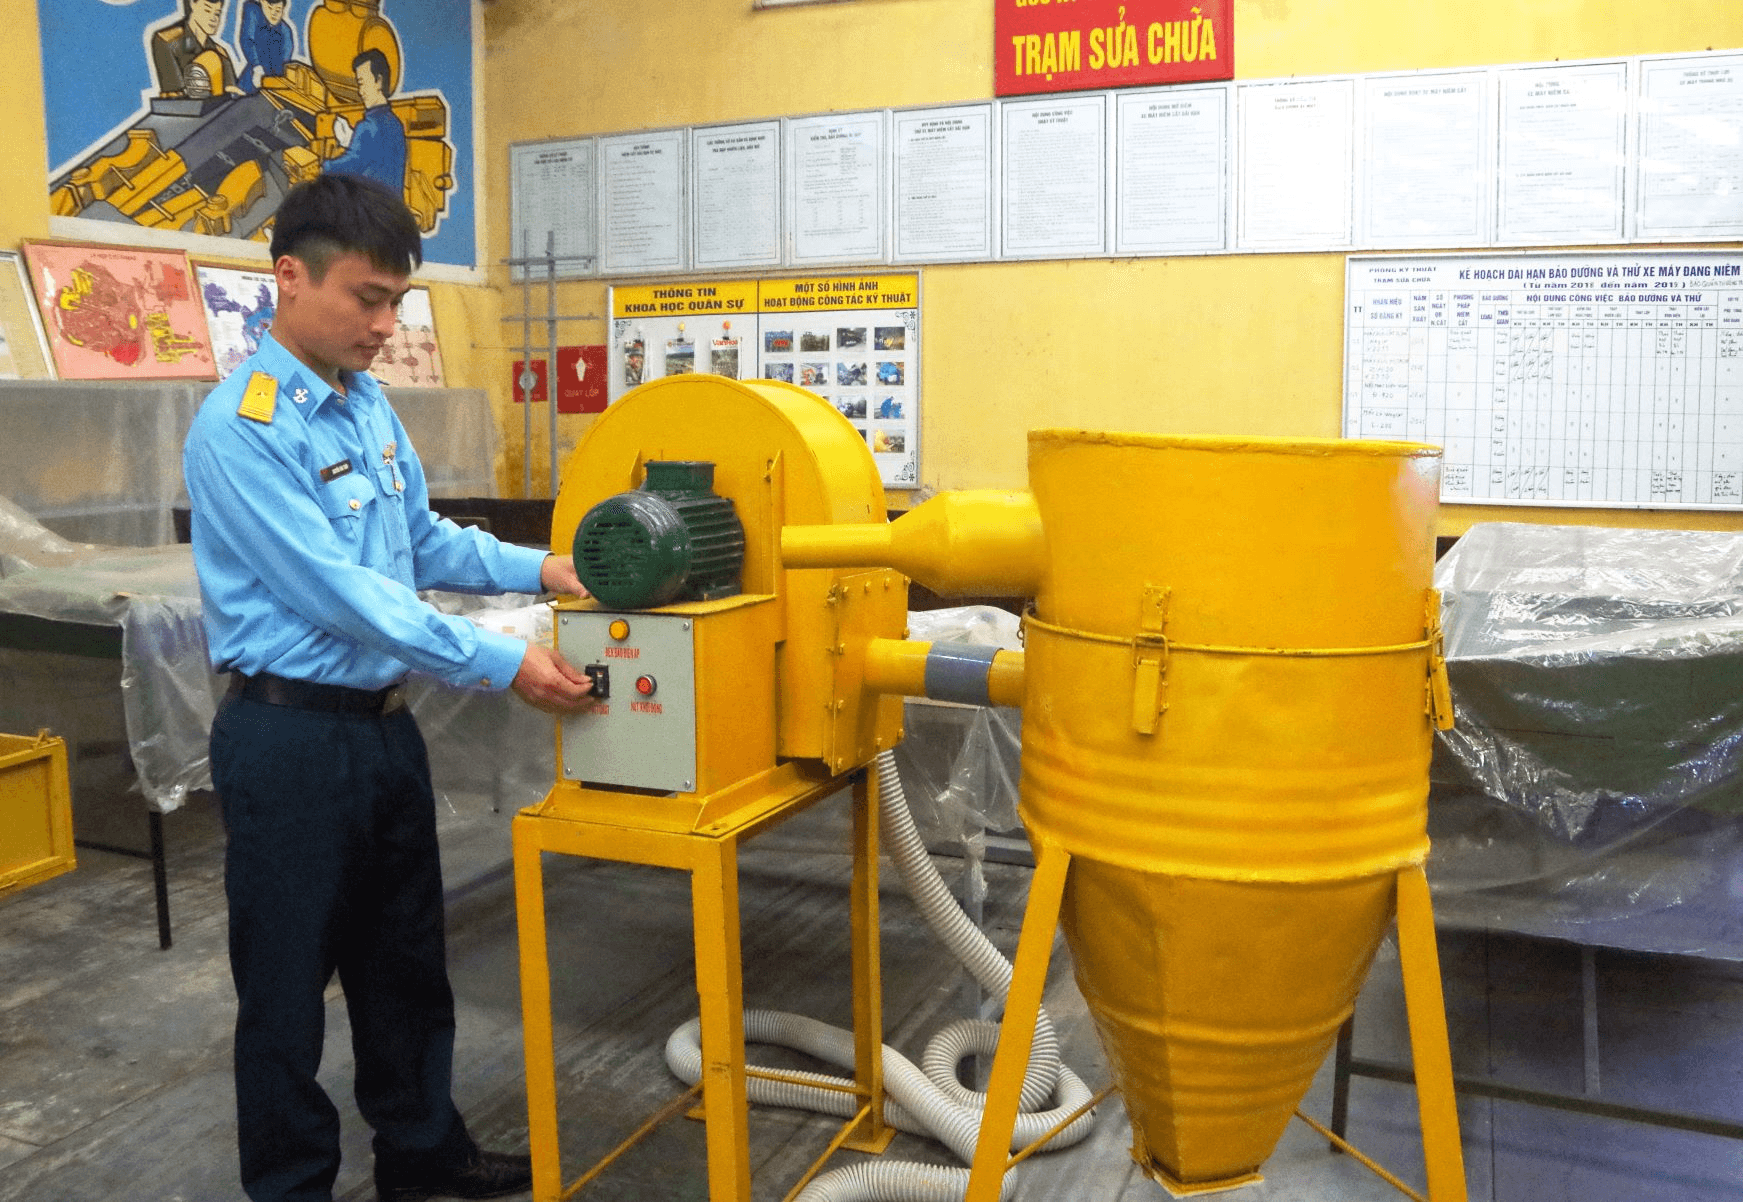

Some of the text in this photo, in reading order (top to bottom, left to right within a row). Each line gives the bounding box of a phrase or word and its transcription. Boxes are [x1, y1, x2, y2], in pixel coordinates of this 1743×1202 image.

[1012, 6, 1216, 80] TRẠM SỬA CHỮA
[1459, 263, 1740, 281] KẾ HOẠCH DÀI HẠN BẢO DƯỠNG VÀ THỬ XE MÁY ĐANG NIÊM
[653, 287, 716, 299] THÔNG TIN
[795, 277, 878, 294] MỘT SỐ HÌNH ẢNH
[625, 298, 745, 312] KHOA HỌC QUÂN SỰ
[764, 297, 787, 308] HOẠT
[790, 294, 815, 308] ĐỘNG
[817, 294, 844, 305] CÔNG
[846, 293, 864, 304] TÁC
[881, 291, 911, 304] THUẬT
[1527, 294, 1540, 303] NỘI
[1569, 293, 1592, 302] CÔNG
[1595, 293, 1613, 303] VIỆC
[1619, 292, 1636, 302] BẢO
[1638, 292, 1668, 302] DƯỠNG
[1671, 292, 1681, 302] VÀ
[1685, 292, 1702, 302] THỬ
